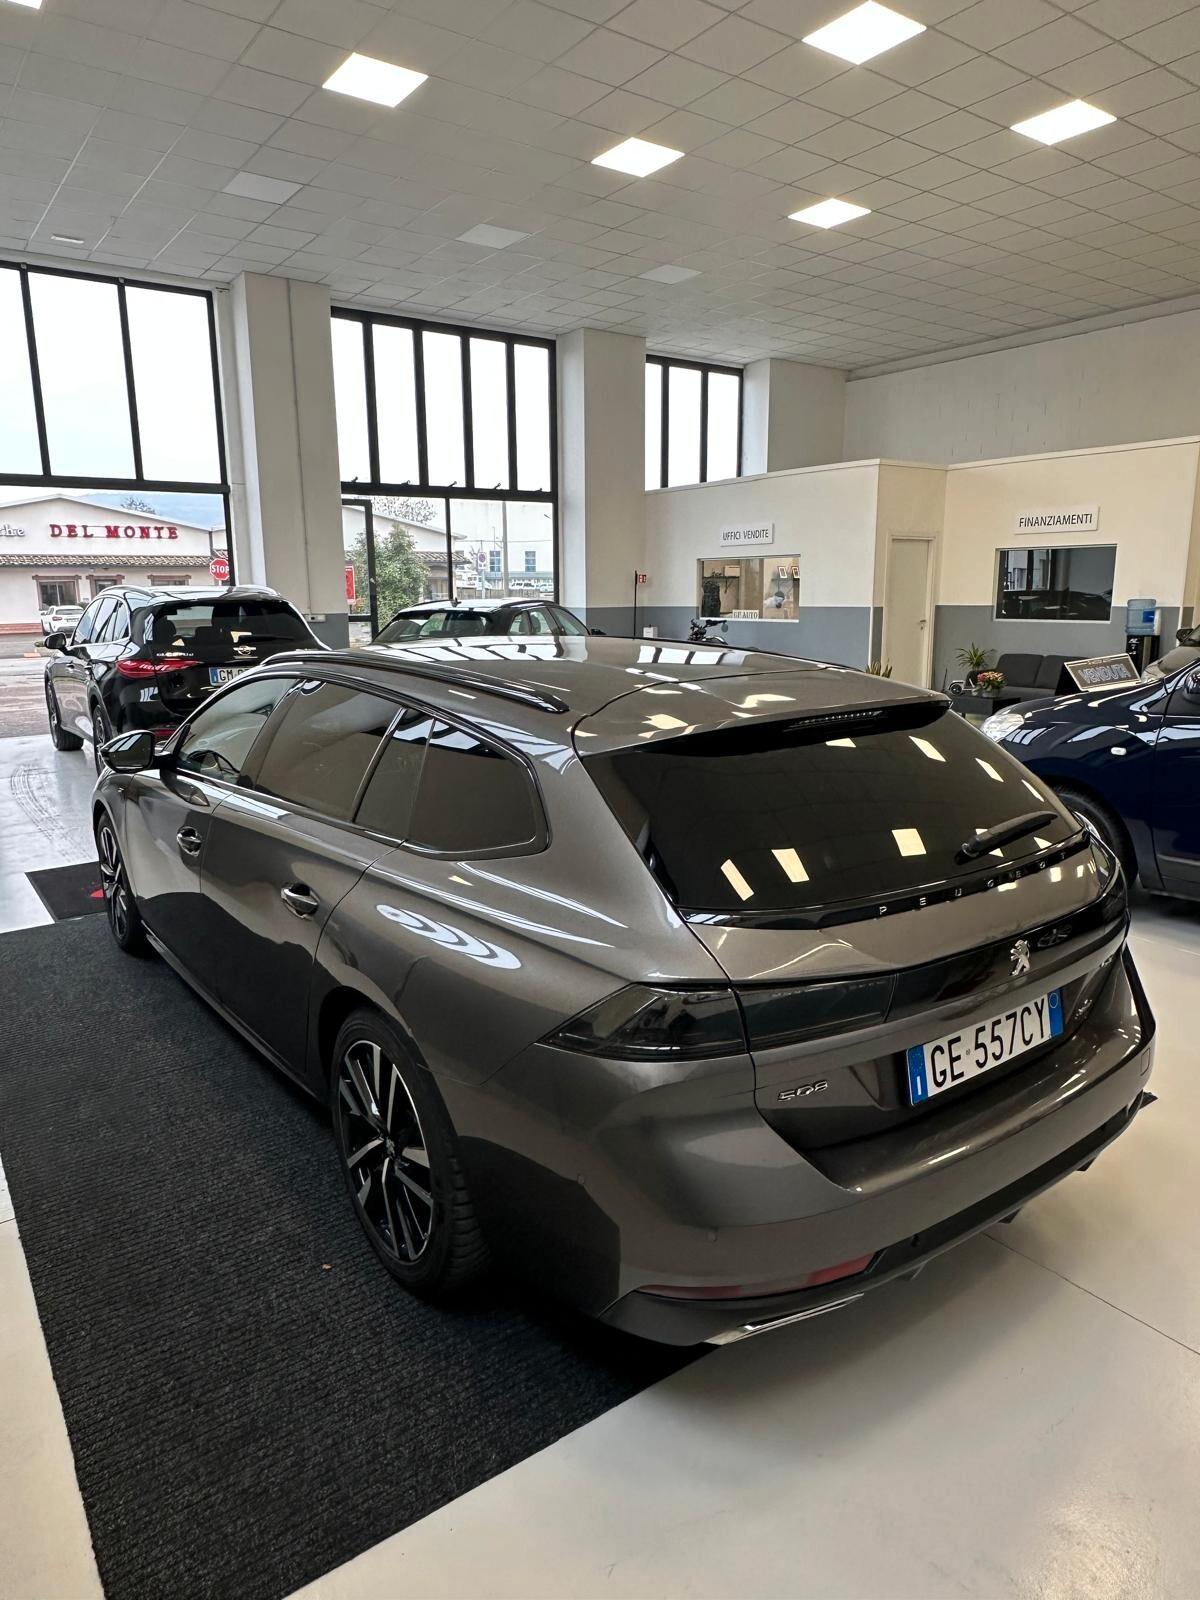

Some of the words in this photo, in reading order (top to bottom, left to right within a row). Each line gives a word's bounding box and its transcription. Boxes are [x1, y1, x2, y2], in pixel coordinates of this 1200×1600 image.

[1019, 513, 1093, 528] FINANZIAMENTI
[50, 524, 94, 538] DEL
[106, 525, 178, 540] MONTE
[722, 531, 741, 541] UFFICI
[743, 529, 769, 540] VENDITE
[211, 564, 229, 574] STOP
[879, 852, 1066, 915] PEUGEOT
[930, 1035, 965, 1088] GE
[974, 997, 1048, 1069] 557CY
[778, 1079, 829, 1101] 508
